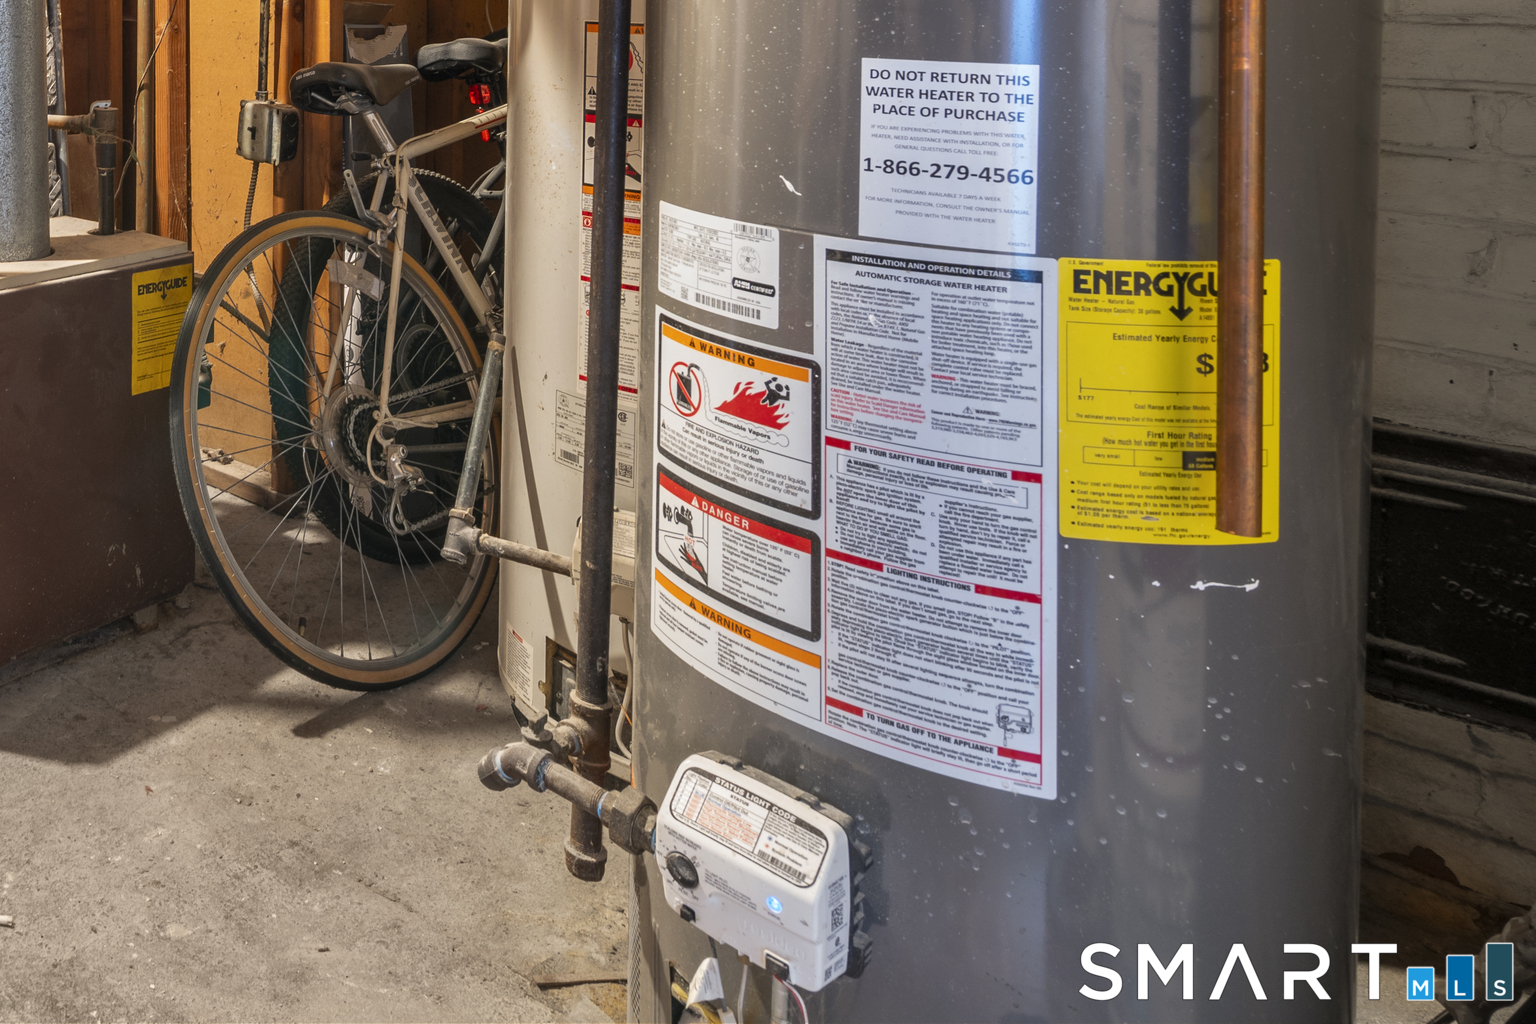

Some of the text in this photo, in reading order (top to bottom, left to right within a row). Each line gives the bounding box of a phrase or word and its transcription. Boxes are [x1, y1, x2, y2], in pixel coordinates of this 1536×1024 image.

[870, 68, 1029, 86] DO NOT RETURN THIS
[866, 86, 1033, 105] WATER HEATER TO THE
[873, 103, 1024, 123] PLACE OF PURCHASE
[864, 157, 1033, 185] 1-866-279-4566
[852, 255, 1011, 279] INSTALLATION AND OPERATION DETAILS
[138, 276, 188, 296] ENERGYGUIDE
[855, 270, 1007, 294] AUTOMATIC STORAGE WATER HEATER
[1113, 333, 1208, 344] Estimated Yearly Energy
[700, 340, 756, 367] WARNING
[686, 422, 759, 455] FIRE AND EXPLOSION HAZARD
[715, 416, 771, 440] Flammable Vapors
[1188, 432, 1212, 440] Rating
[691, 431, 702, 440] result
[708, 440, 724, 450] serious
[726, 446, 740, 456] injury
[748, 453, 764, 464] death
[854, 444, 1007, 479] FOR YOUR SAFETY READ BEFORE OPERATING
[702, 502, 750, 530] DANGER
[684, 536, 695, 546] HOT
[887, 567, 970, 592] LIGHTING INSTRUCTIONS
[701, 605, 752, 640] WARNING
[866, 712, 993, 754] TO TURN GAS OFF TO THE APPLIANCE
[715, 778, 796, 823] STATUS LIGHT CODE
[730, 794, 749, 806] STATUS
